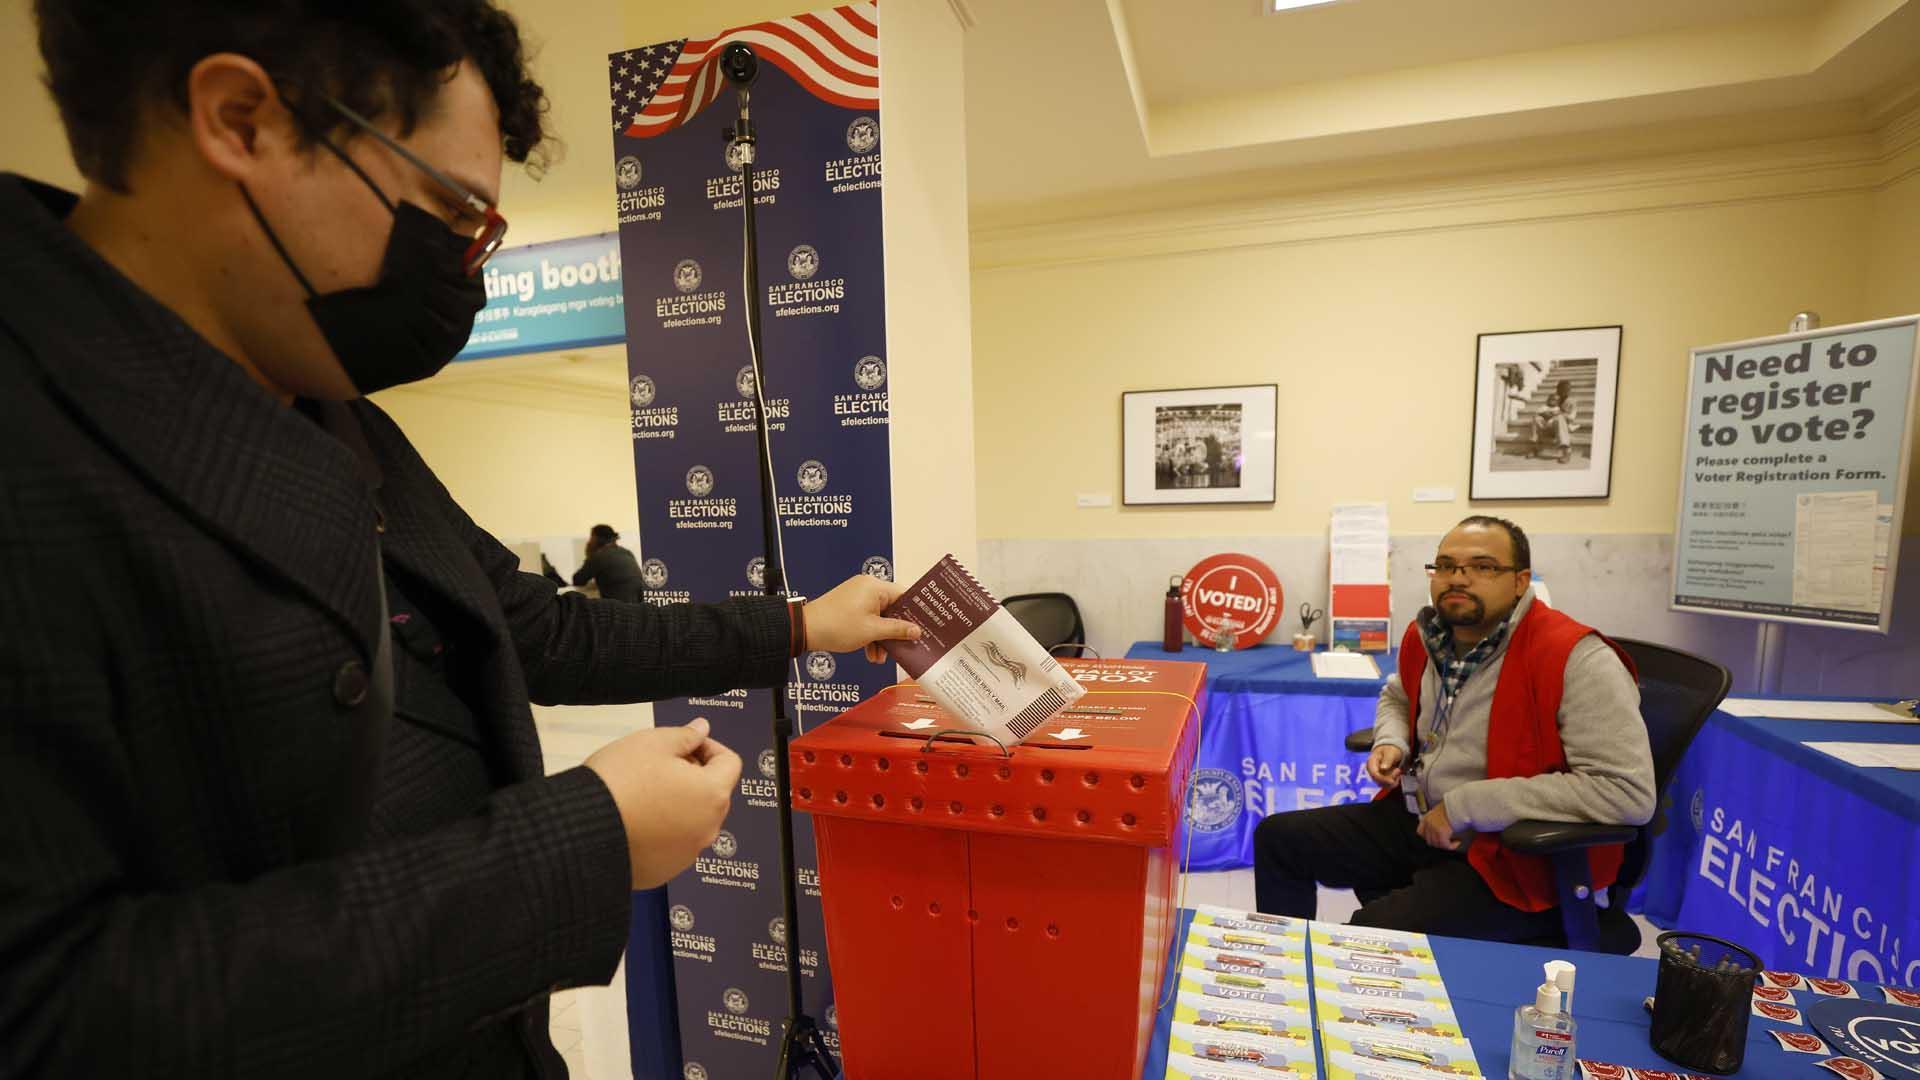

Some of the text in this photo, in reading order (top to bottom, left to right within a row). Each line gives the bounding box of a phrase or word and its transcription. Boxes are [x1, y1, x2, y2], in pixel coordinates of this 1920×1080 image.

[826, 154, 881, 169] SAN FRANC
[826, 162, 882, 181] ELECTIO
[706, 176, 780, 199] ELECONS
[707, 177, 724, 186] SAN
[832, 179, 882, 194] sfelections
[616, 194, 665, 212] ECTIONS
[713, 194, 776, 210] sfelectis.org
[618, 211, 662, 224] ections.org
[484, 267, 535, 302] ting
[768, 279, 845, 293] SAN FRANCISCO
[656, 291, 726, 305] SAN FRANCISCO
[768, 286, 845, 306] ELECTIONS
[656, 298, 726, 317] ELECTIONS
[775, 303, 840, 317] sfelections.org
[663, 315, 722, 328] sfelections.org
[1704, 341, 1878, 384] Need to
[855, 392, 887, 401] FRANC
[1701, 380, 1872, 421] register
[718, 398, 790, 410] SAN FRAISCO
[834, 400, 889, 415] ELECTIO
[631, 414, 679, 428] ECTIONS
[718, 406, 790, 422] ELECTONS
[841, 416, 888, 427] sfelections
[1698, 408, 1875, 447] to vote?
[632, 430, 675, 439] ections.org
[1696, 452, 1828, 467] Please complete a
[1695, 469, 1887, 485] Voter Registration Form.
[688, 498, 737, 506] FRANCISCO
[798, 494, 852, 503] FRANCISCO
[669, 504, 737, 518] ELECTIONS
[778, 502, 852, 516] ELECTIONS
[676, 519, 733, 530] sfelections.org
[785, 517, 848, 528] sfelections.org
[1230, 575, 1238, 591] I
[729, 590, 746, 598] SAN
[1199, 588, 1263, 613] VOTED!
[920, 586, 953, 621] Envelope
[927, 580, 951, 604] Ballot
[948, 600, 973, 628] Return
[1074, 674, 1154, 683] BOX
[788, 682, 860, 691] SAN FRANCISCO
[788, 689, 860, 703] ELECTIONS
[688, 698, 744, 710] sfelections.org
[1241, 756, 1297, 782] SAN
[1710, 808, 1758, 860] SAN
[713, 858, 759, 870] FRANCISCO
[695, 863, 760, 880] ELECTIONS
[701, 876, 756, 891] sfelections.org
[1700, 834, 1885, 984] ELECTIO
[1228, 920, 1267, 931] VOTE!
[671, 937, 716, 953] ECTIONS
[752, 942, 768, 950] SAN
[1223, 941, 1265, 952] VOTE!
[673, 950, 712, 963] ections.org
[1220, 964, 1265, 975] VOTE!
[1351, 962, 1396, 975] VOTE!
[1219, 988, 1265, 1000] VOTE!
[1355, 987, 1403, 998] VOTE!
[707, 1017, 770, 1036] ELECTIONS
[724, 1013, 770, 1026] FRANCISCO
[1861, 1035, 1920, 1055] VO
